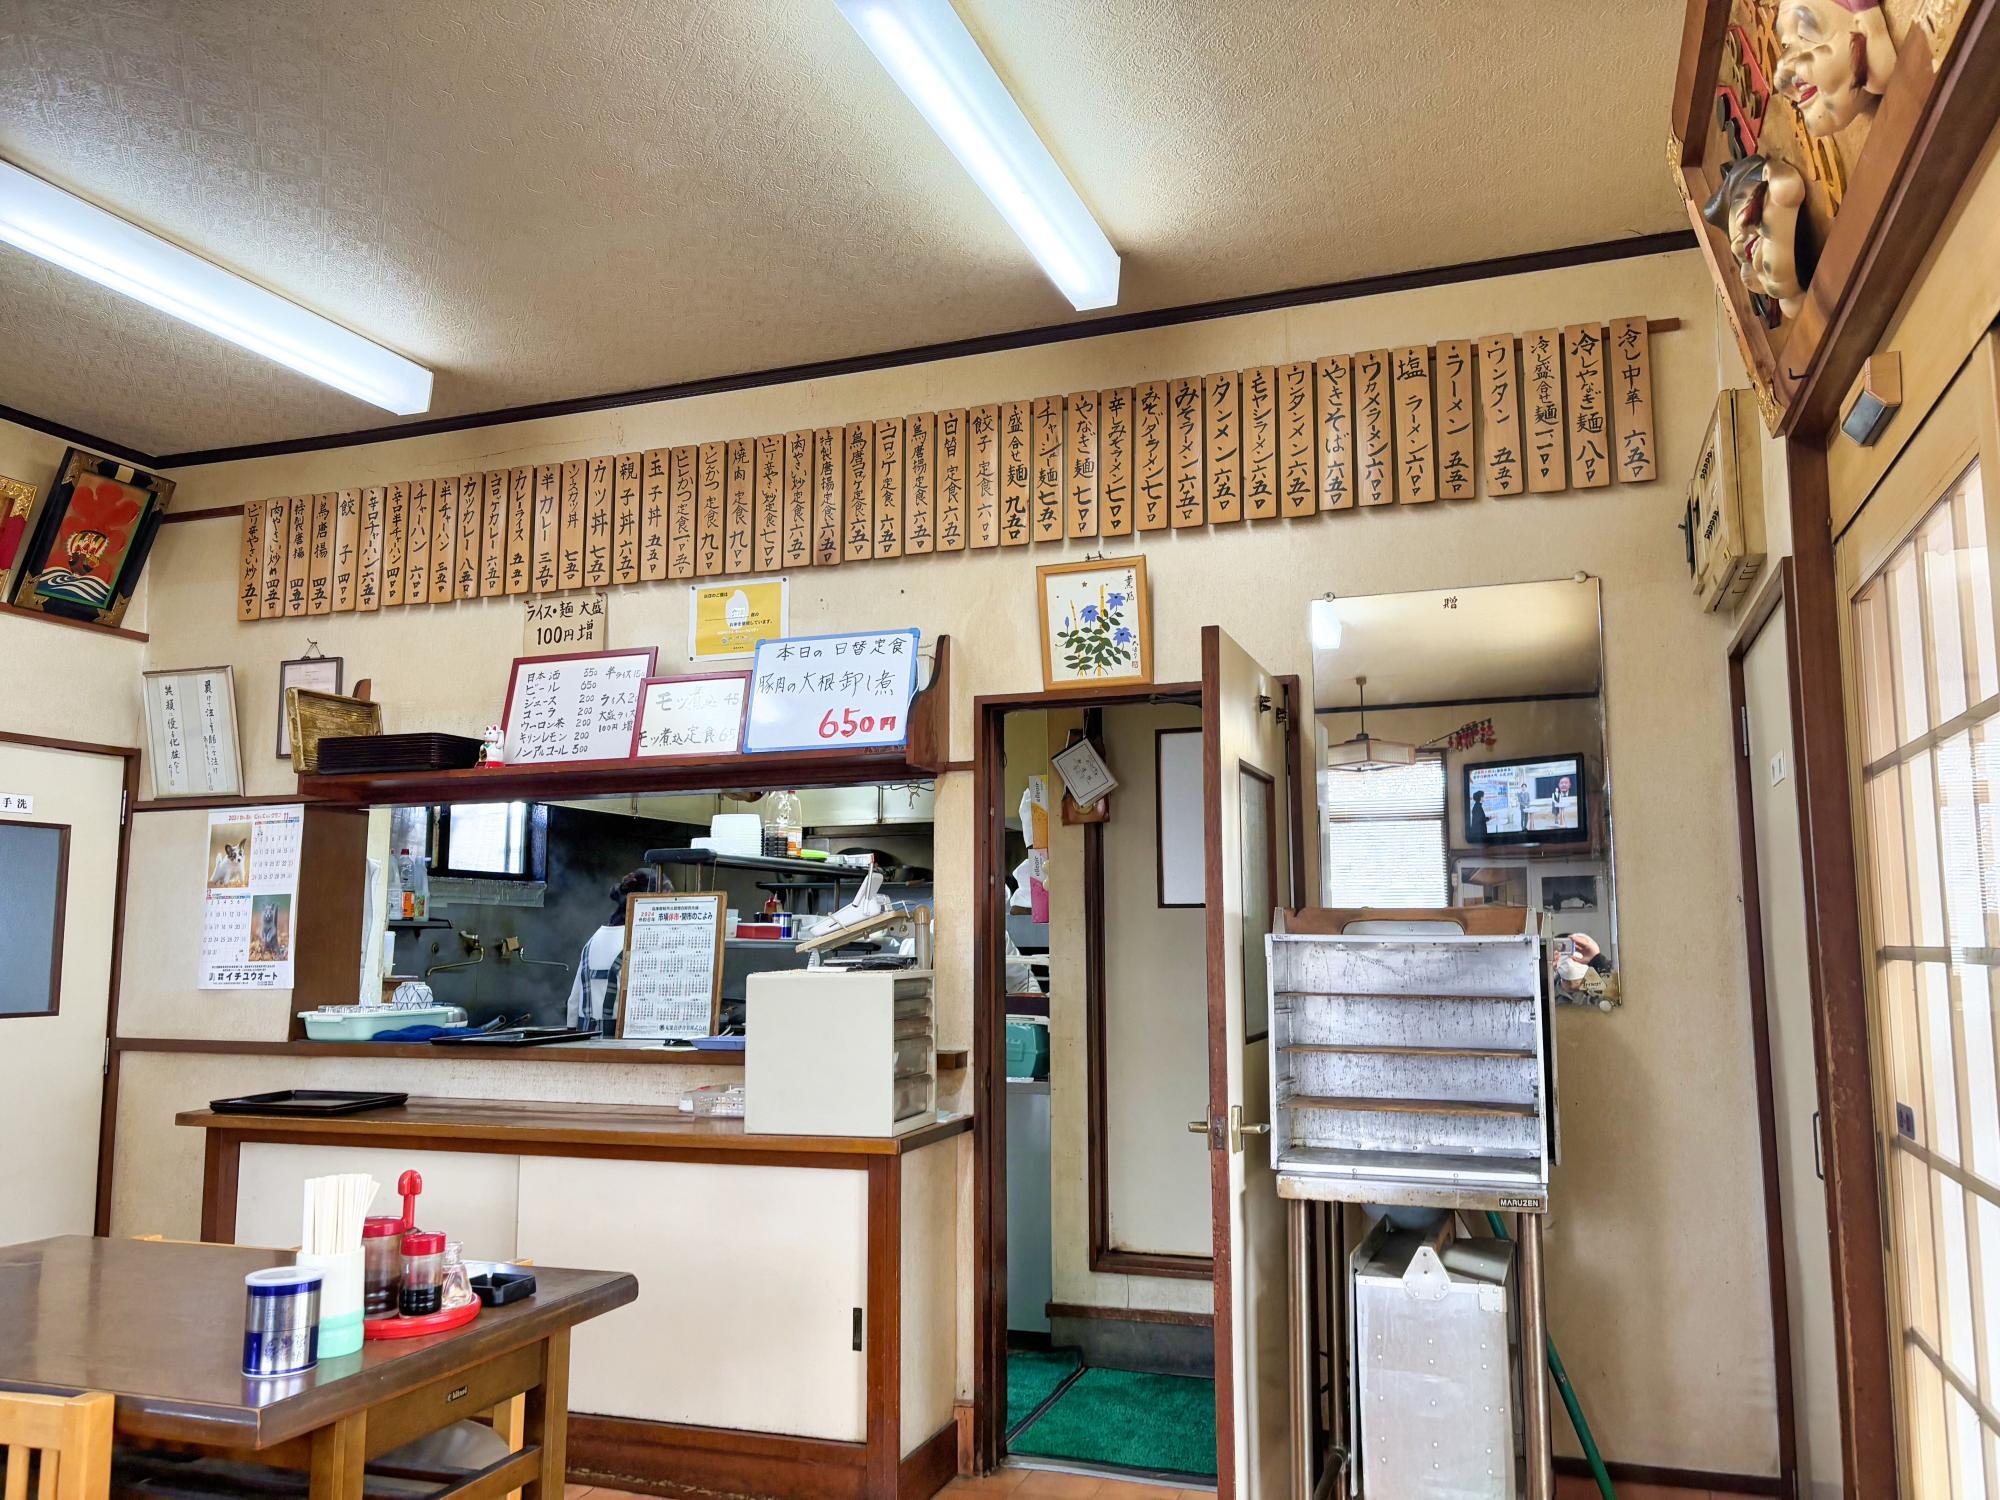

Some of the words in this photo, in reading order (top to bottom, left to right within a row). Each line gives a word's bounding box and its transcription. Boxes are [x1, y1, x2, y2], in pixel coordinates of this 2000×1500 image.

[579, 599, 604, 615] 大盛
[776, 643, 822, 661] 本日の
[835, 638, 907, 656] 日替定食
[527, 670, 560, 682] 日本酒
[526, 682, 560, 695] ビール
[581, 680, 596, 690] 650
[524, 696, 557, 709] ジュース
[579, 694, 594, 703] 200
[523, 707, 556, 719] コーラ
[577, 707, 592, 716] 200
[520, 718, 566, 732] ウーロン茶
[575, 719, 591, 728] 200
[818, 707, 896, 738] 650円
[574, 732, 589, 740] 200
[572, 745, 588, 754] 500
[1500, 1199, 1538, 1207] MARUZEN
